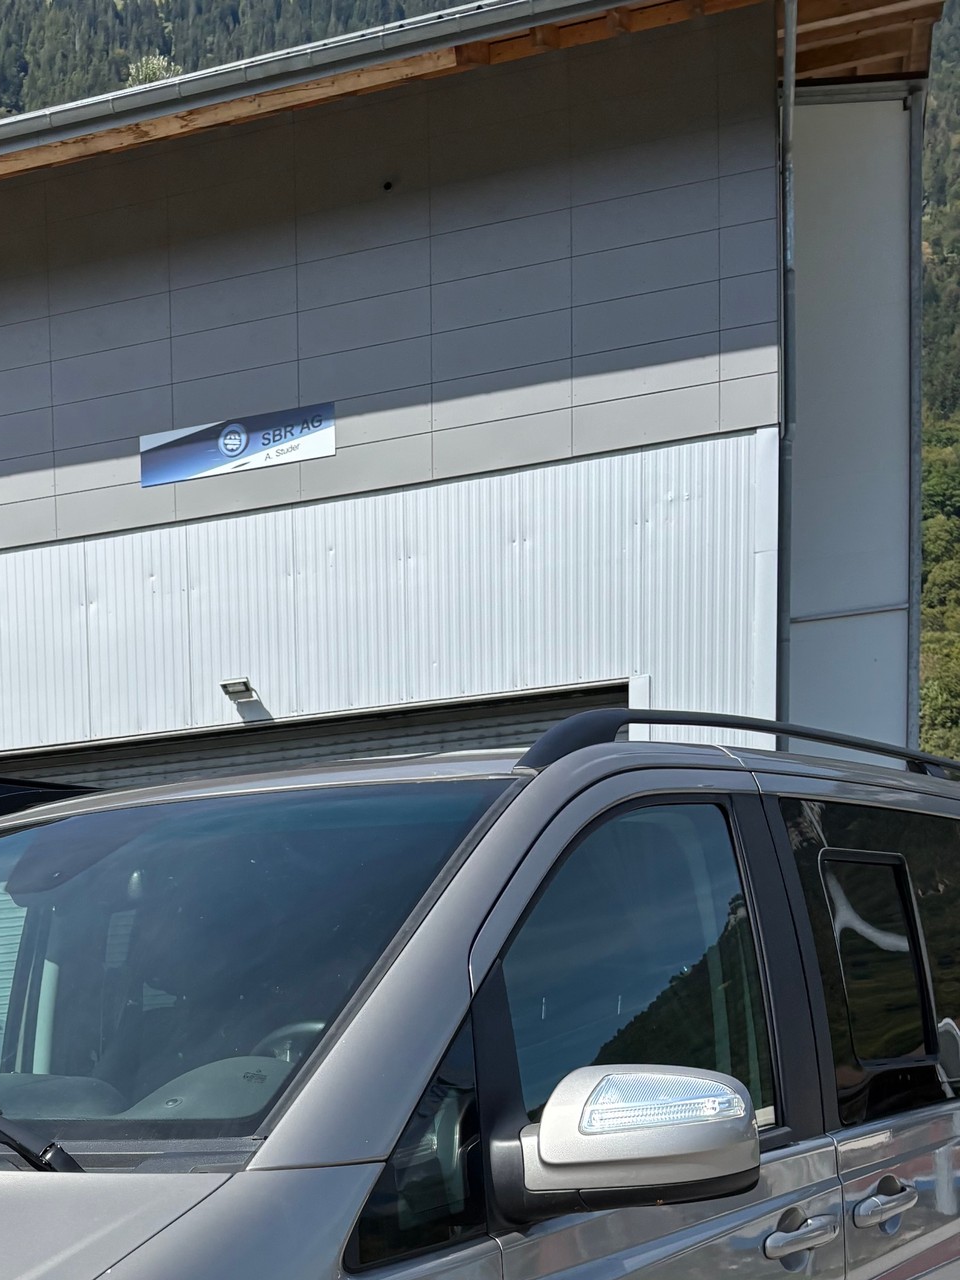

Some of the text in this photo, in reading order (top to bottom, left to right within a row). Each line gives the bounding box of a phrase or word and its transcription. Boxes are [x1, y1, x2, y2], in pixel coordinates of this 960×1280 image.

[261, 414, 323, 446] SBR AG
[275, 443, 301, 457] Studer
